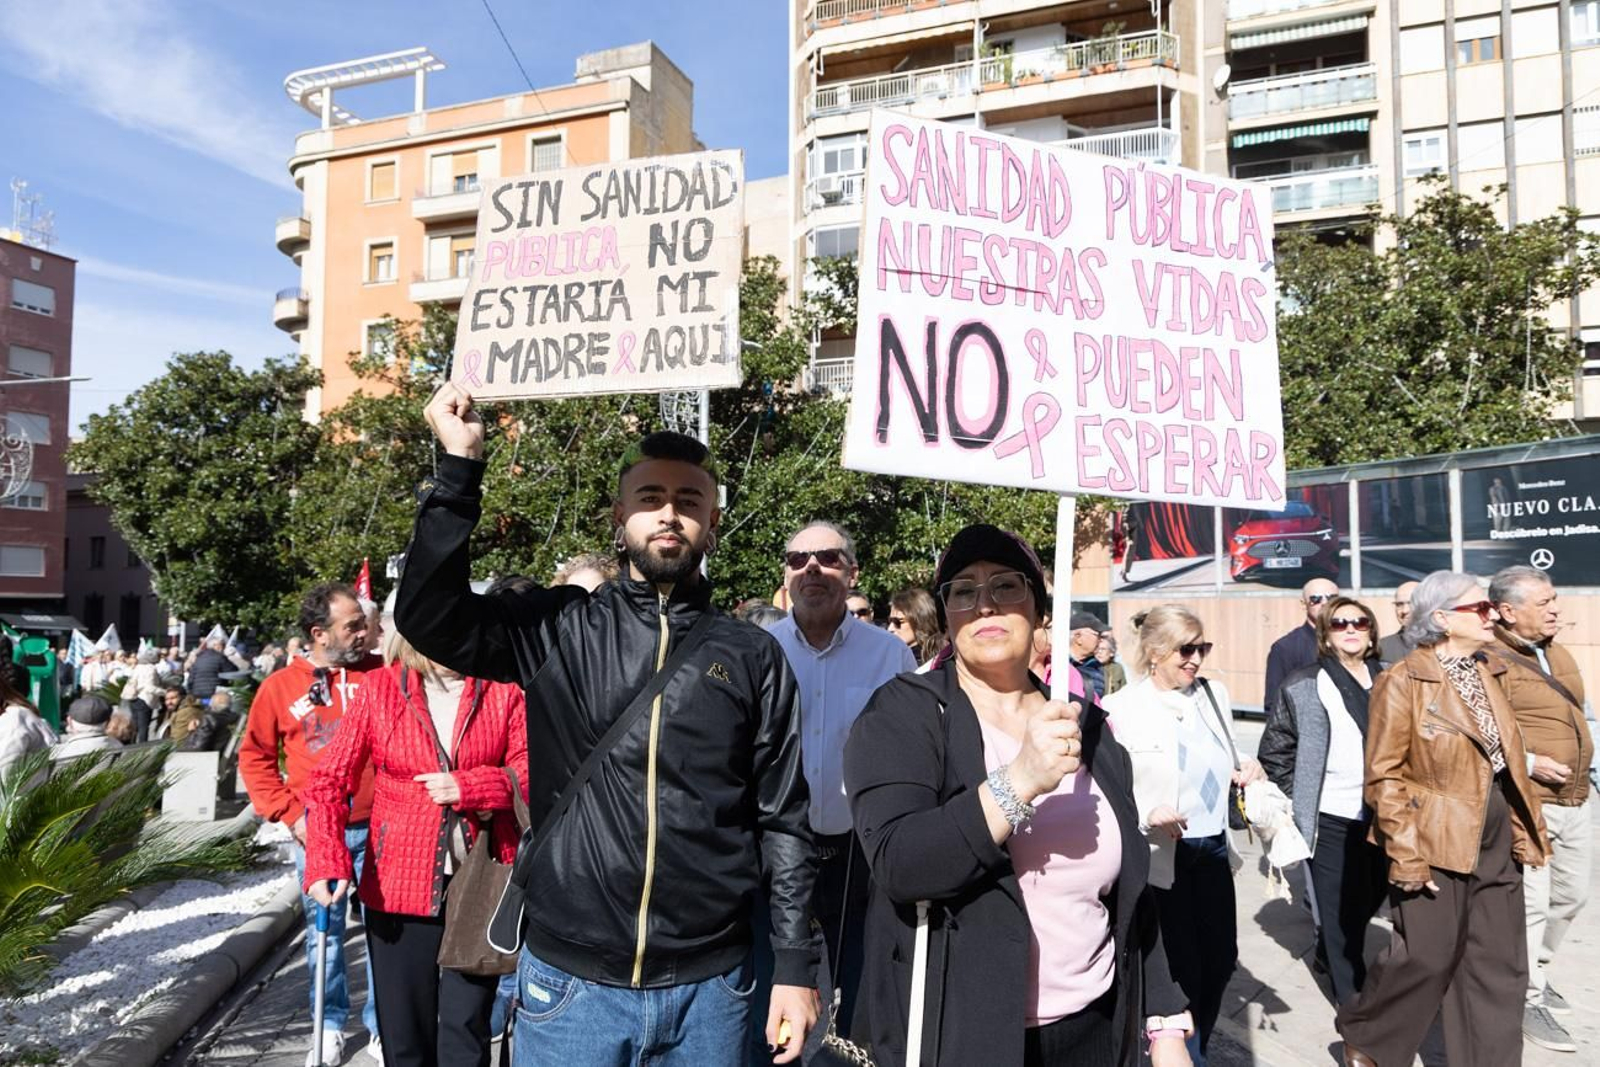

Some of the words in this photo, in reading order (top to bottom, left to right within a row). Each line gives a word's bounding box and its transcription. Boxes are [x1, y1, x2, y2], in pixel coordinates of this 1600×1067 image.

[490, 178, 563, 233] SIN
[580, 161, 738, 222] SANIDAD
[880, 124, 1073, 239] SANIDAD
[1104, 162, 1267, 263] PÚBLICA
[648, 217, 714, 269] NO
[876, 217, 1108, 321] NUESTRAS
[1132, 259, 1269, 344] VIDAS
[470, 278, 632, 332] ESTARIA
[656, 271, 719, 317] MI
[485, 332, 611, 385] MADRE
[874, 313, 1011, 452] NO
[1074, 332, 1244, 422] PUEDEN
[1075, 415, 1282, 501] ESPERAR
[1487, 499, 1550, 518] NUEVO
